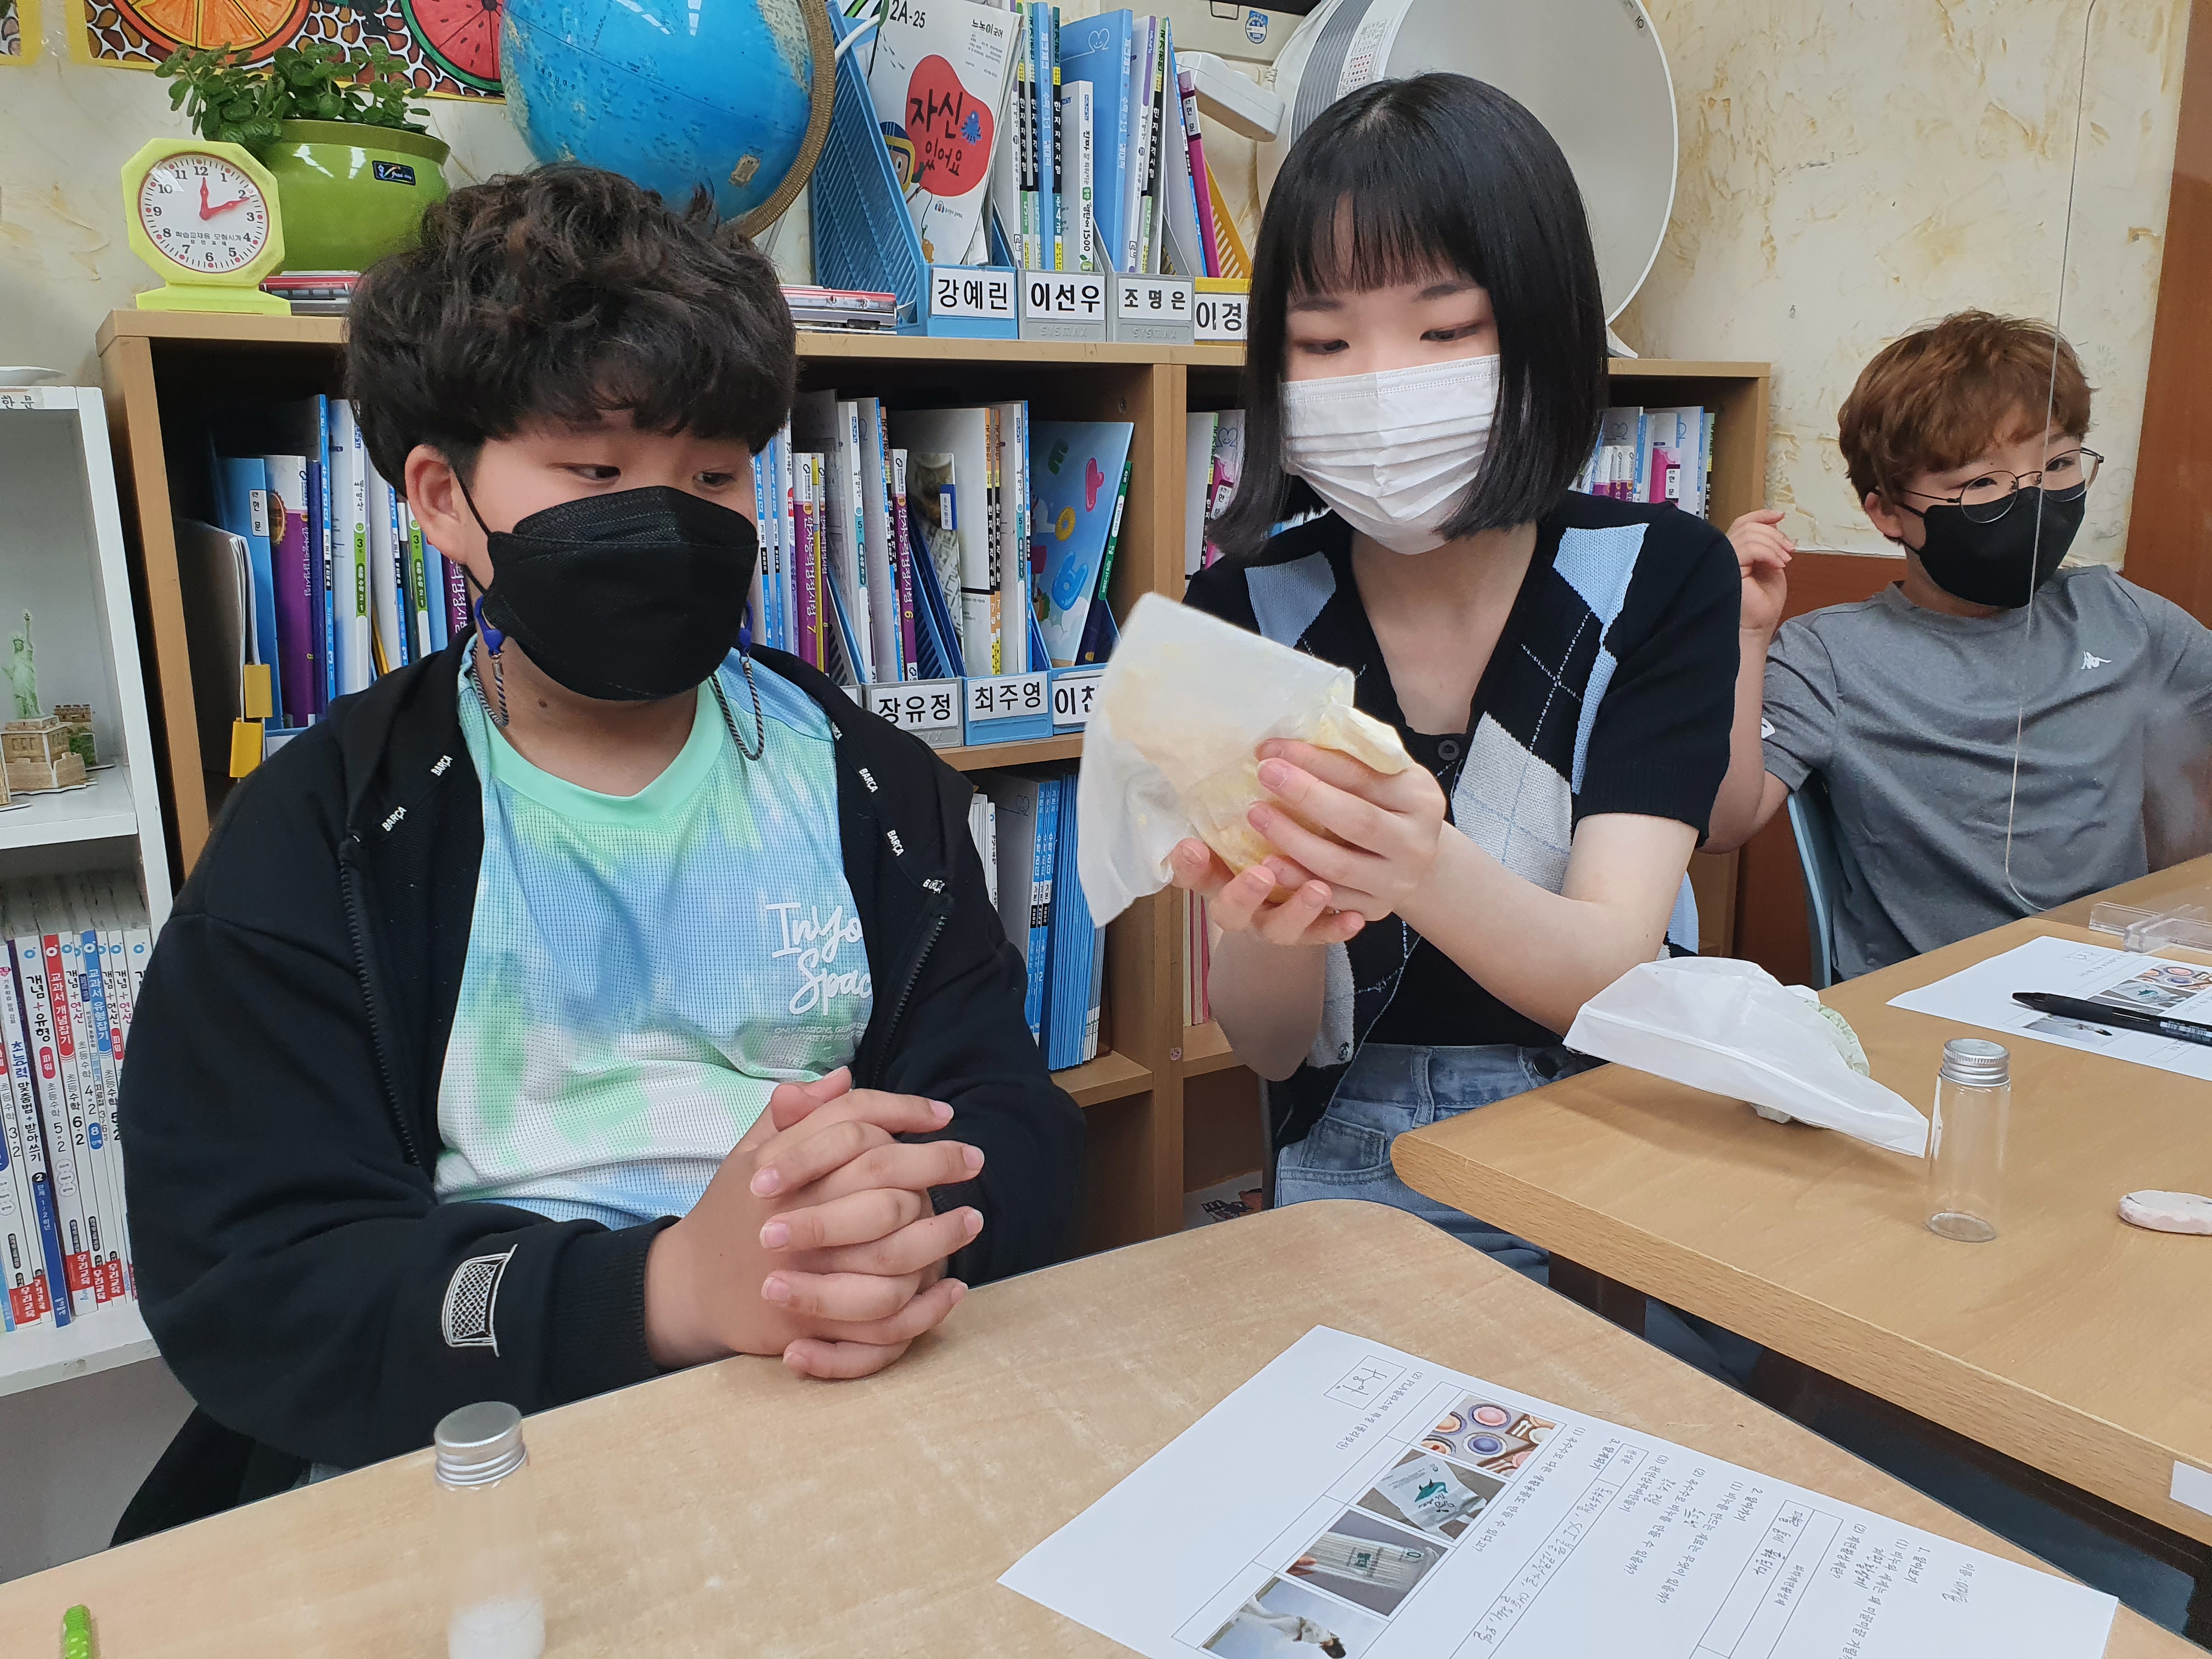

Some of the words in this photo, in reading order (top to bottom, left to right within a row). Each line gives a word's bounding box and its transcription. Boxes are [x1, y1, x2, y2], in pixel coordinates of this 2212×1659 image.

[889, 0, 926, 28] 2A-25
[910, 88, 963, 139] 자신
[1083, 131, 1090, 151] 진짜
[924, 138, 963, 177] 있어요
[175, 170, 188, 179] 11
[194, 166, 208, 176] 12
[221, 173, 227, 182] 1
[158, 184, 173, 194] 10
[238, 189, 246, 199] 2
[153, 207, 162, 216] 9
[246, 212, 255, 222] 3
[1084, 202, 1092, 228] 영단어
[162, 228, 171, 238] 8
[243, 233, 251, 242] 4
[182, 245, 190, 254] 7
[205, 252, 214, 261] 6
[228, 247, 237, 257] 5
[937, 279, 1008, 311] 강예린
[1030, 283, 1101, 313] 이선우
[857, 521, 863, 530] 5
[357, 538, 363, 548] 3
[413, 534, 420, 544] 3
[899, 508, 913, 603] 한자능력검정시험
[804, 516, 816, 617] 한자능력검정시험
[904, 610, 914, 619] 6
[806, 625, 816, 634] 7
[974, 682, 1042, 712] 최주영
[878, 692, 951, 723] 장유정
[431, 754, 453, 777] BARÇA
[859, 766, 879, 794] BARÇA
[381, 805, 408, 833] BARÇA
[885, 829, 904, 857] BARÇA
[50, 973, 65, 1002] 교과서
[88, 969, 103, 998] 교과서
[55, 1005, 72, 1045] 개념잡기
[93, 1001, 110, 1040] 유형잡기
[11, 1041, 29, 1078] 초능력
[42, 1054, 53, 1071] 파워
[18, 1081, 33, 1114] 맞춤법
[91, 1126, 99, 1136] 8
[25, 1122, 41, 1162] 받아쓰기
[36, 1173, 43, 1182] 2
[1411, 1371, 1424, 1380] (2)
[1378, 1379, 1415, 1411] PLA플라스틱
[1572, 1427, 1586, 1436] (1)
[1553, 1437, 1578, 1459] 옥수수로
[1589, 1446, 1615, 1470] 알게되기
[1541, 1461, 1557, 1473] 다른
[1655, 1455, 1669, 1465] (3)
[1692, 1468, 1706, 1478] (2)
[1514, 1474, 1545, 1504] 생활용품도
[1674, 1479, 1699, 1503] 옥수수로
[1729, 1481, 1744, 1491] (1)
[1716, 1492, 1736, 1511] 비누를
[1733, 1496, 1758, 1522] 알아가기
[1501, 1505, 1519, 1519] 만들
[1658, 1504, 1680, 1523] 비누를
[1702, 1513, 1723, 1531] 만드는
[1562, 1521, 1583, 1542] SCI
[1647, 1525, 1665, 1538] 만들
[1852, 1523, 1867, 1534] (2)
[1472, 1527, 1498, 1552] 있다고?
[1688, 1532, 1708, 1553] 재료는
[1894, 1538, 1910, 1550] (1)
[1623, 1549, 1647, 1575] 있을까?
[1672, 1555, 1696, 1577] 무엇이
[1752, 1559, 1773, 1575] 된다
[1829, 1535, 1860, 1579] 계면활성제란?
[1903, 1555, 1927, 1584] 알아보기
[1959, 1563, 1976, 1577] 이름
[1655, 1577, 1679, 1604] 있을까?
[1852, 1606, 1876, 1638] 미끌미끌
